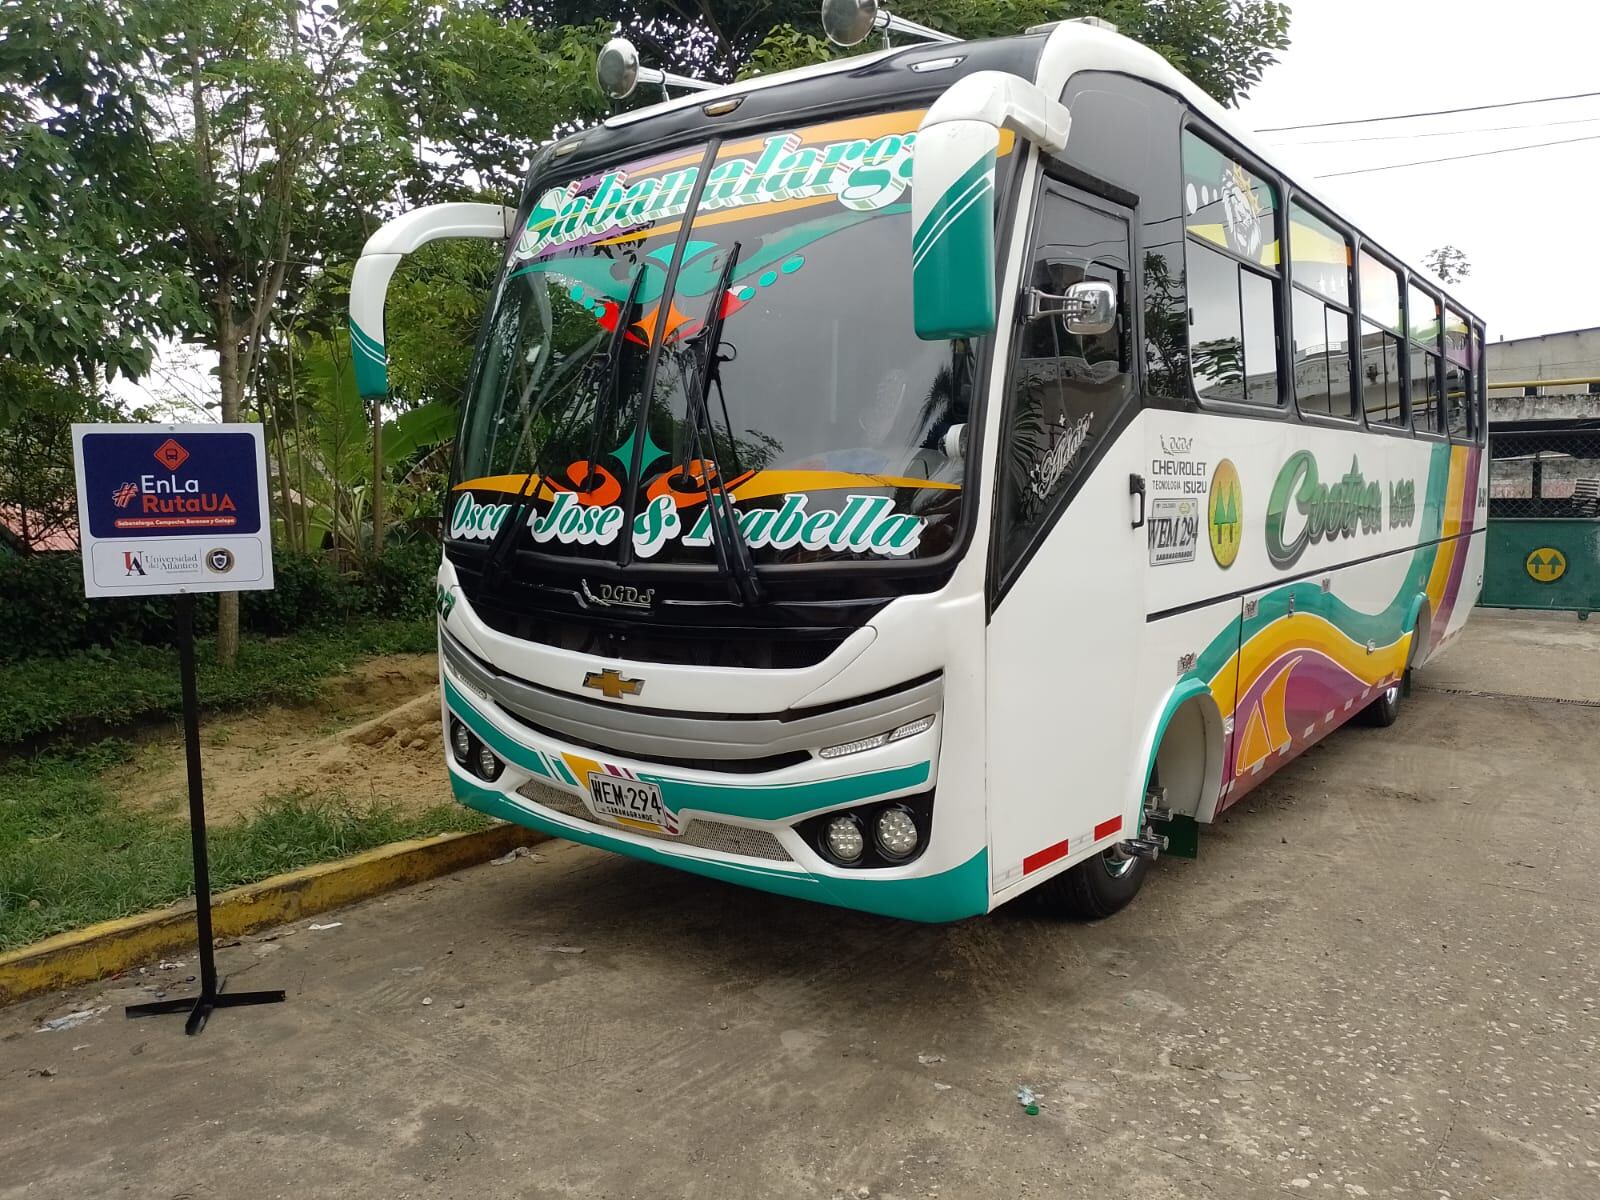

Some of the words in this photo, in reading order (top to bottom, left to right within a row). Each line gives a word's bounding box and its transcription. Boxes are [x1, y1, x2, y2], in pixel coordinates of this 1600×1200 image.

[1152, 460, 1207, 476] CHEVROLET
[141, 474, 199, 493] EnLa
[1183, 480, 1207, 494] ISUZU
[142, 493, 237, 513] RutaUA
[451, 491, 537, 541] Osca
[632, 493, 682, 558] &
[682, 494, 928, 556] Iabella
[145, 554, 198, 563] Universidad
